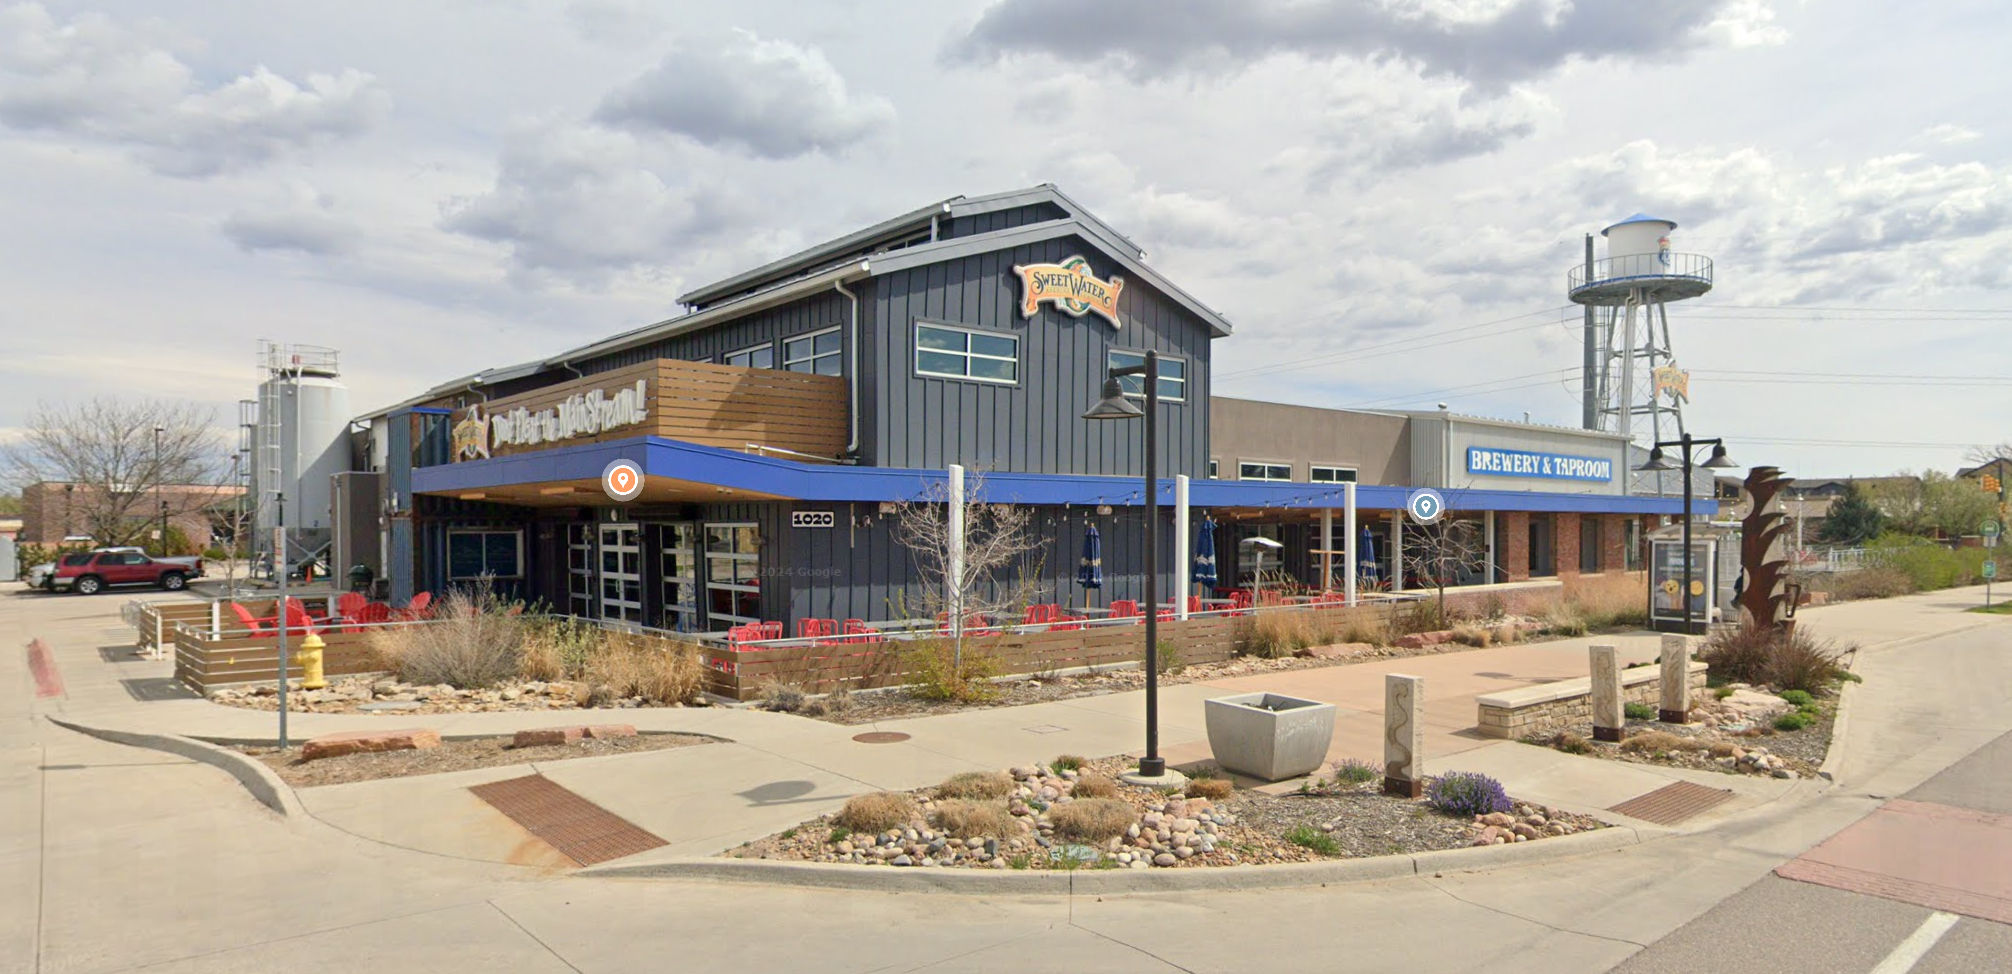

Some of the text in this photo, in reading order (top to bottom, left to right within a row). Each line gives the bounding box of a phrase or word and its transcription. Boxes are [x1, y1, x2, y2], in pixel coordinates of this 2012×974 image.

[1471, 450, 1610, 478] BREWERY & TAPROOM
[794, 514, 832, 524] 1020
